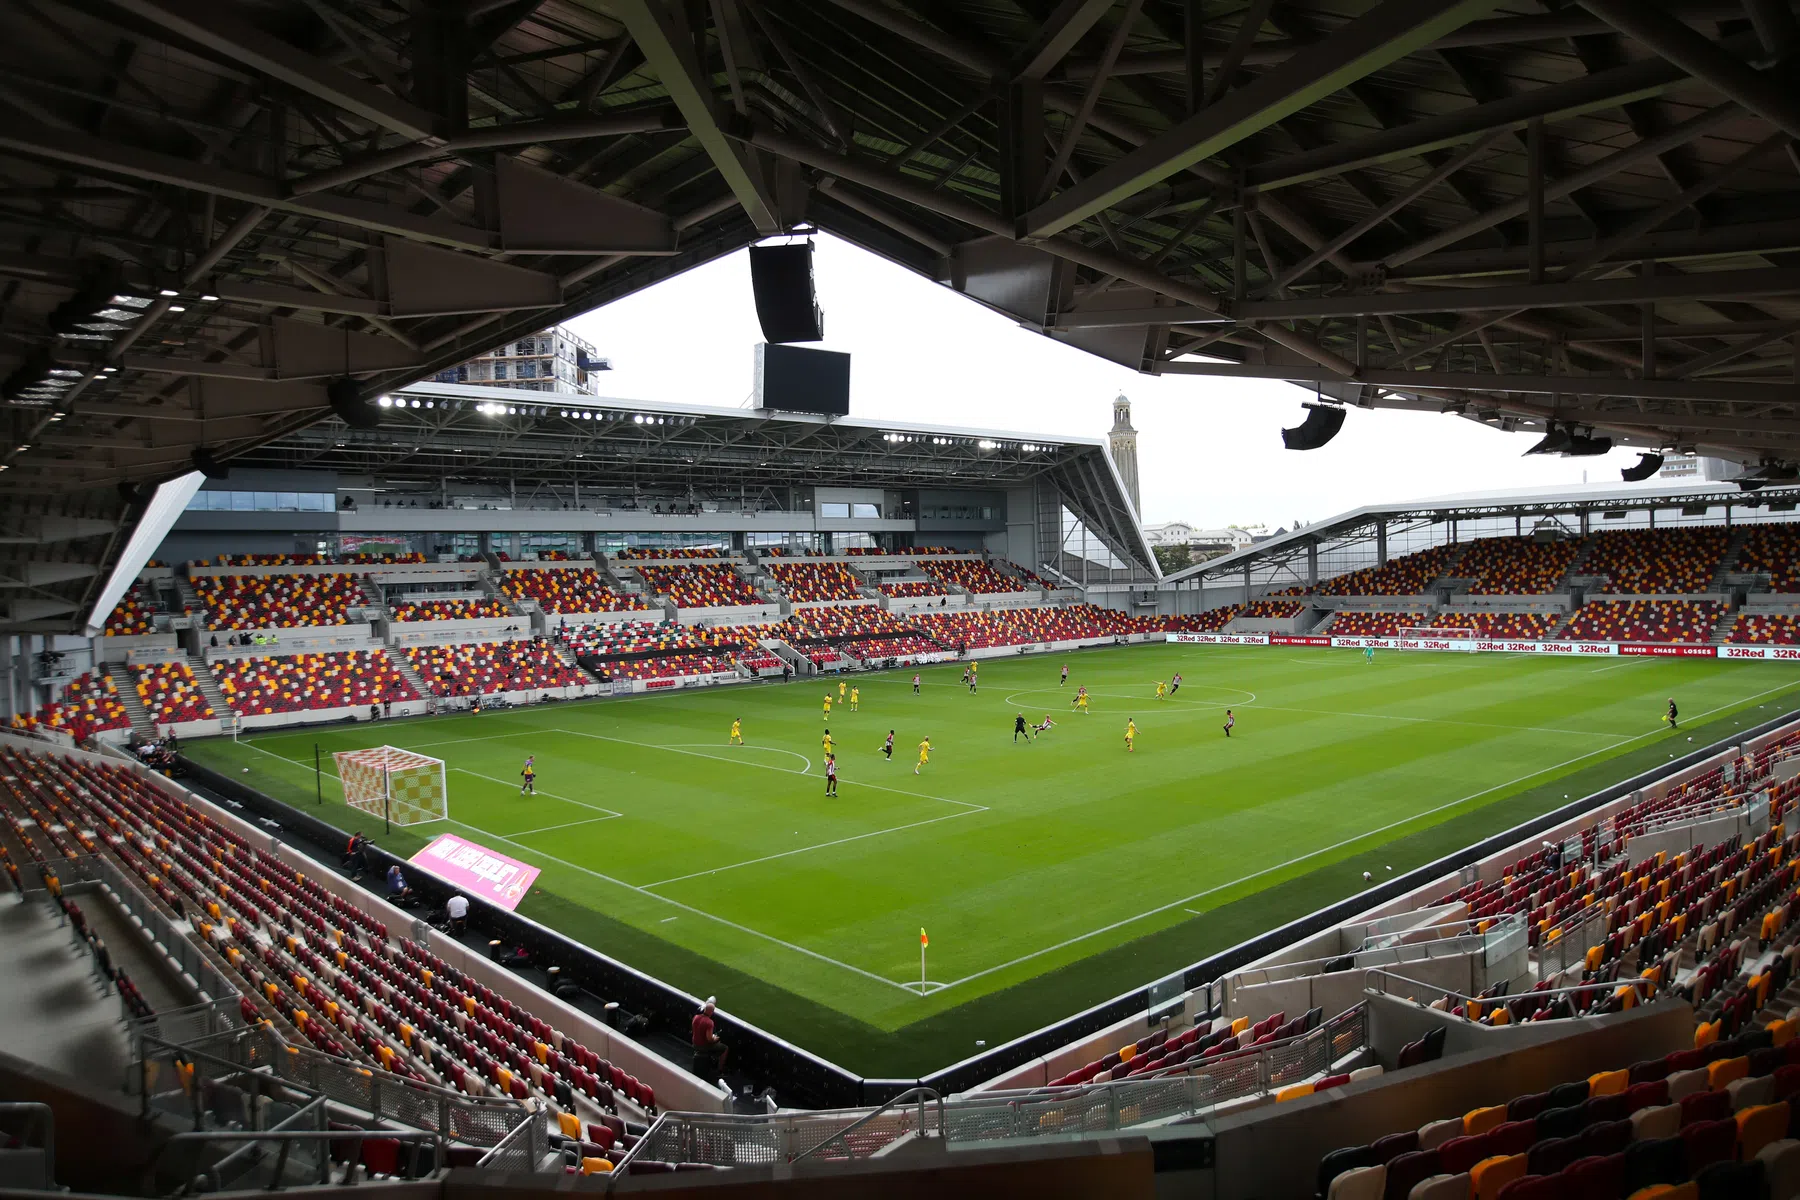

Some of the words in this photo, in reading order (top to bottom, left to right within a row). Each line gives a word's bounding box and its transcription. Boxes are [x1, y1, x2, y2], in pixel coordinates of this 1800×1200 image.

[1476, 642, 1504, 650] 32Red
[1507, 643, 1536, 651] 32Red
[1541, 643, 1572, 652] 32Red
[1578, 644, 1610, 653] 32Red
[1727, 648, 1765, 658] 32Red
